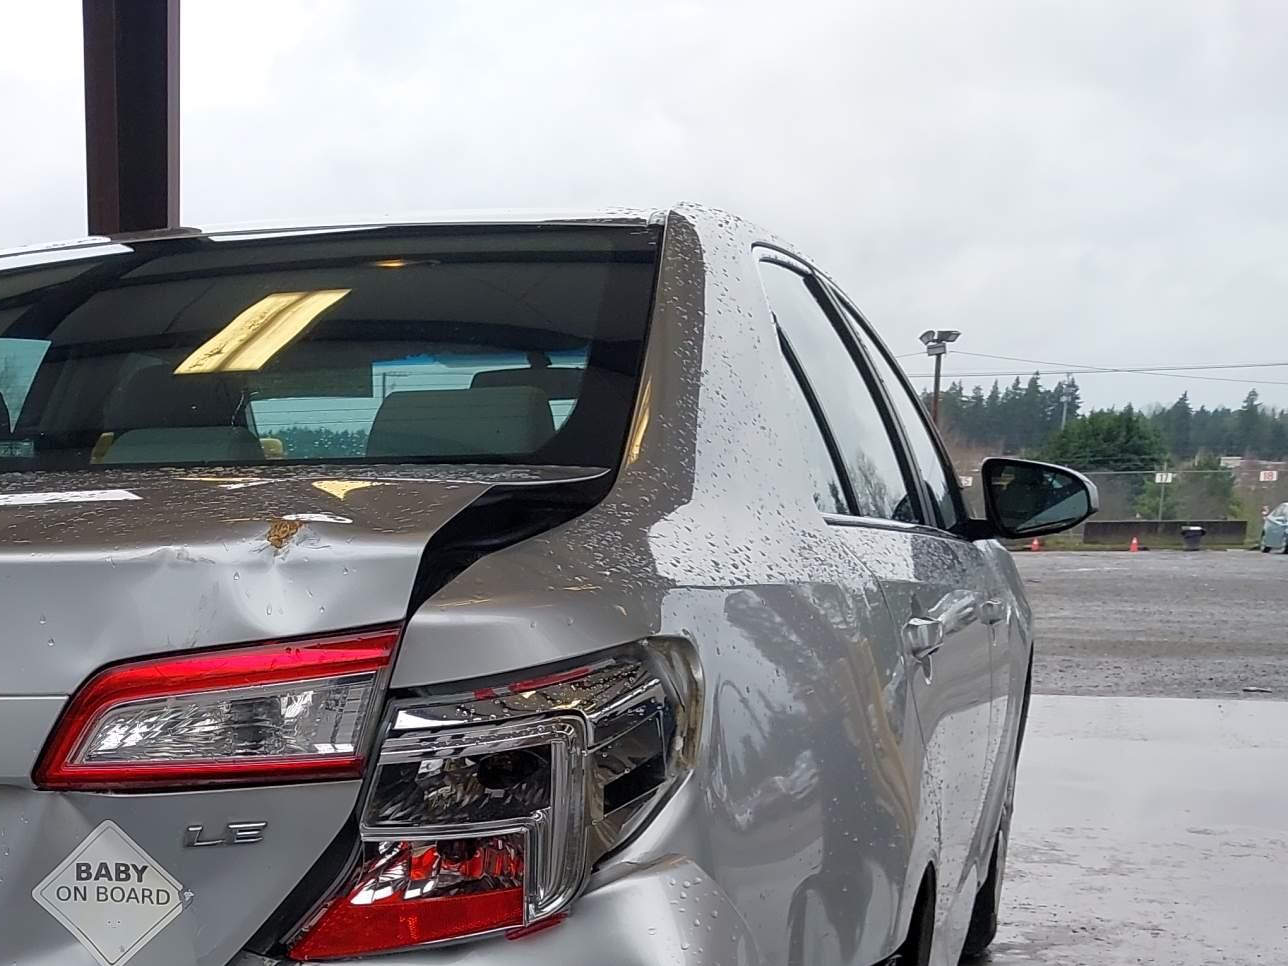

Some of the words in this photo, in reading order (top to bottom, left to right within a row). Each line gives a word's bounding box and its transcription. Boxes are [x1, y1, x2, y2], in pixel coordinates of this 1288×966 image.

[184, 822, 268, 848] LE
[75, 862, 149, 883] BABY
[55, 886, 88, 902] ON
[96, 886, 171, 905] BOARD
